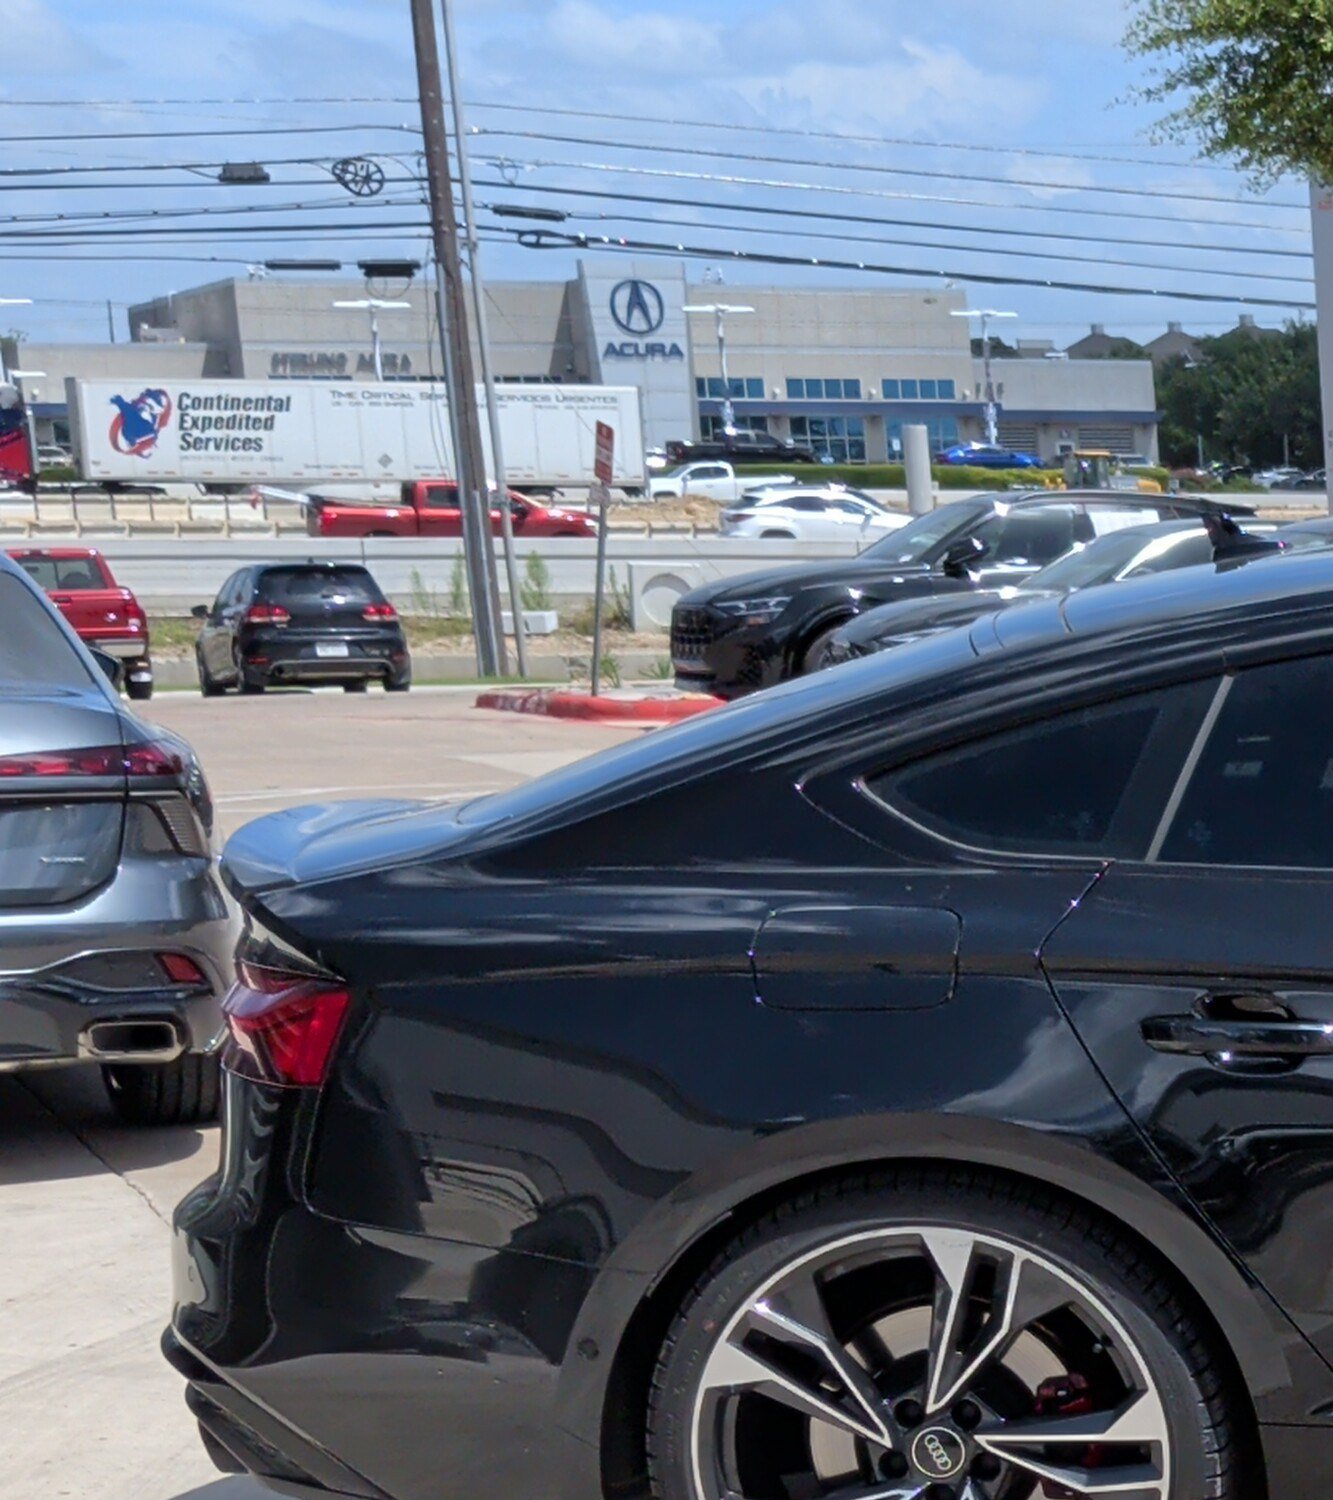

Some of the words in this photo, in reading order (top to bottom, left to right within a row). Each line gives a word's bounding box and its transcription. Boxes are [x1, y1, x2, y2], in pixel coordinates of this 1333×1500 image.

[603, 342, 684, 357] ACURA
[177, 392, 292, 412] Continental
[178, 412, 275, 434] Expedited
[179, 432, 264, 452] Services
